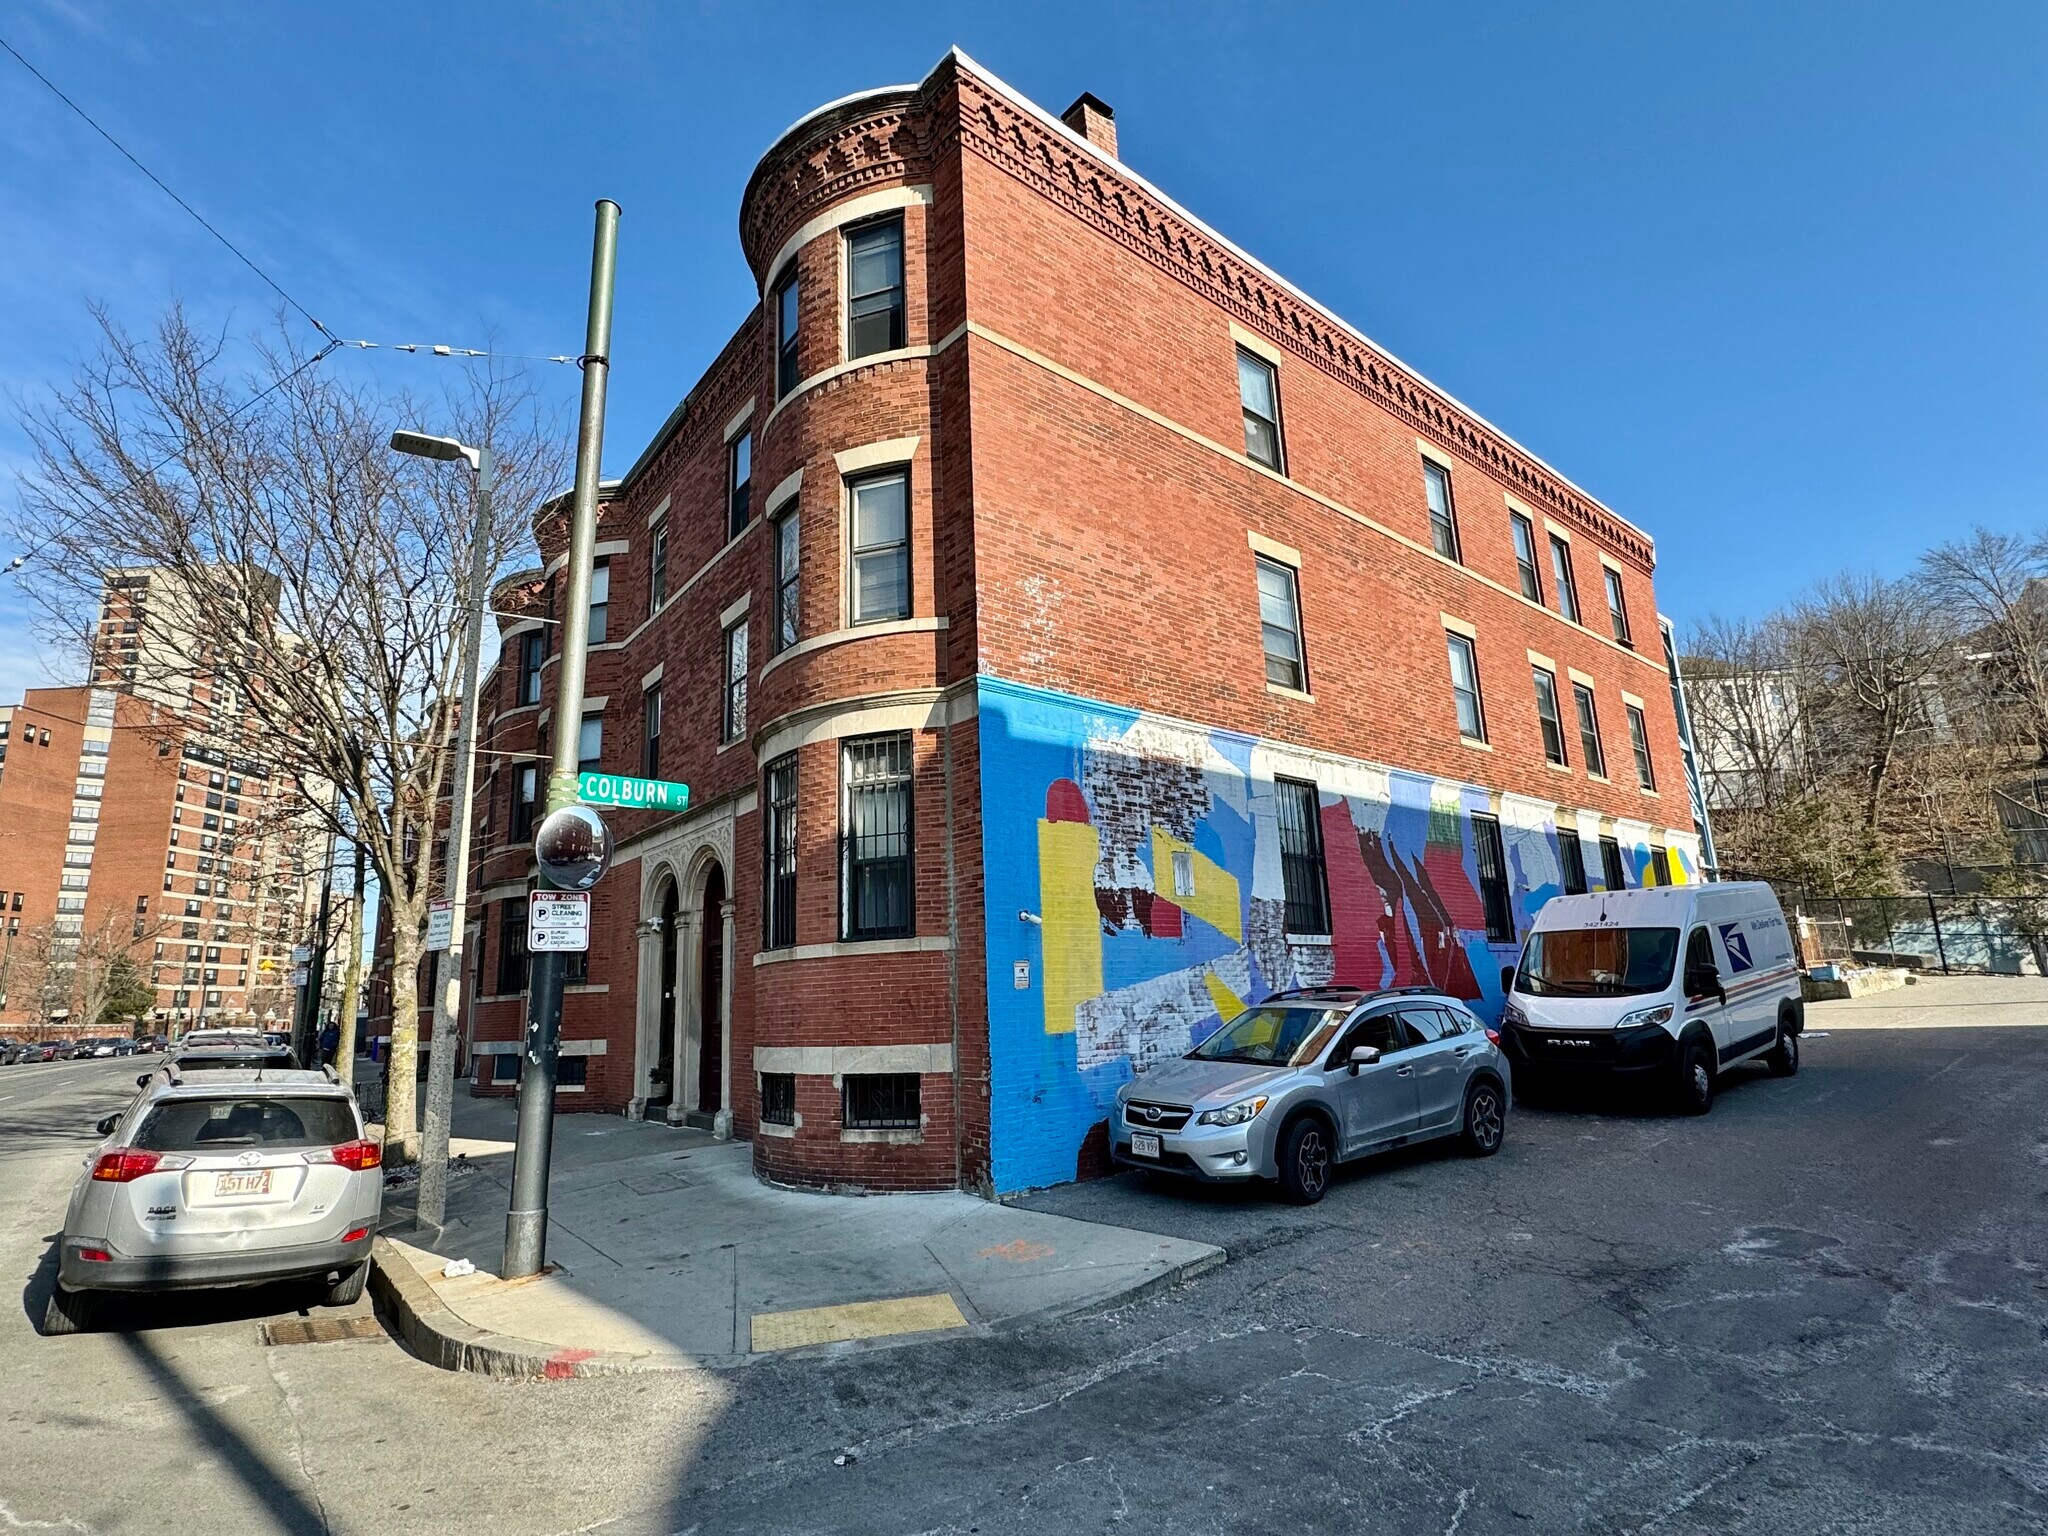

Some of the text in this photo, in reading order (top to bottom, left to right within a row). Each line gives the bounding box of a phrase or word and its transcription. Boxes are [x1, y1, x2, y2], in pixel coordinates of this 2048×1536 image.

[586, 776, 687, 806] COLBURN ST
[535, 893, 585, 901] TOW ZONE
[1547, 1039, 1590, 1047] RAM
